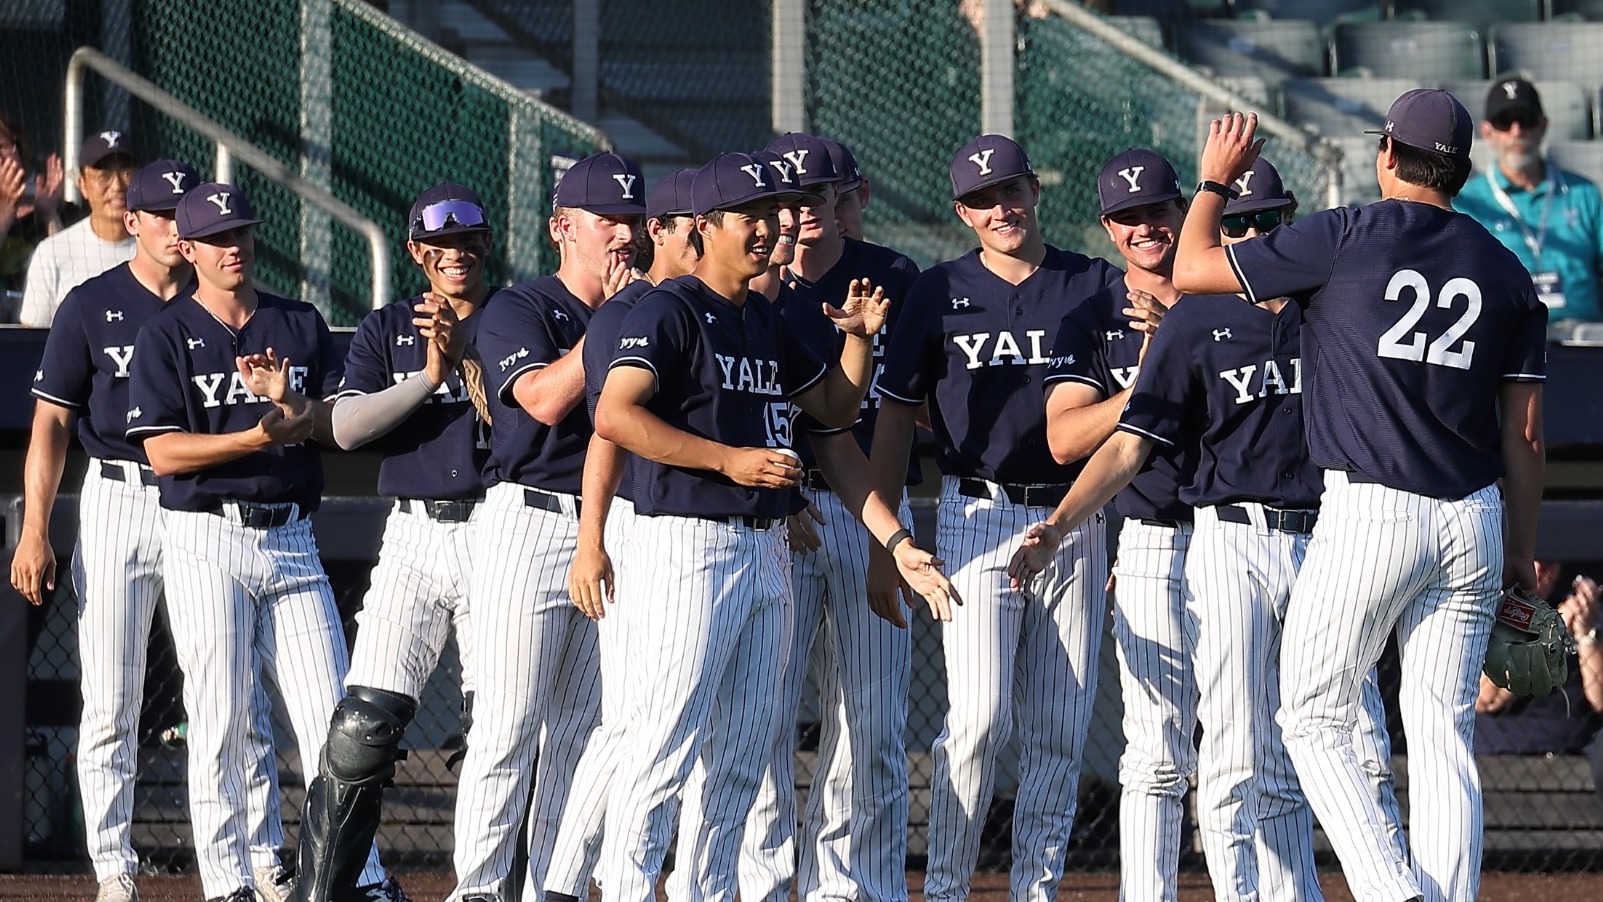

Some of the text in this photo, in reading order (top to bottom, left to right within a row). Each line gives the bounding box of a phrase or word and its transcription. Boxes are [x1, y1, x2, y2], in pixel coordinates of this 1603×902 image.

[100, 130, 122, 148] Y
[1434, 141, 1458, 154] YALE
[740, 163, 766, 187] Y
[769, 160, 793, 184] Y
[783, 149, 809, 175] Y
[968, 148, 995, 177] Y
[162, 171, 186, 194] Y
[612, 173, 636, 199] Y
[1118, 166, 1145, 193] Y
[1235, 170, 1255, 197] Y
[207, 192, 231, 215] Y
[1377, 269, 1482, 370] 22
[953, 330, 1053, 370] YAL
[191, 366, 308, 408] YAE
[715, 353, 782, 395] YALE
